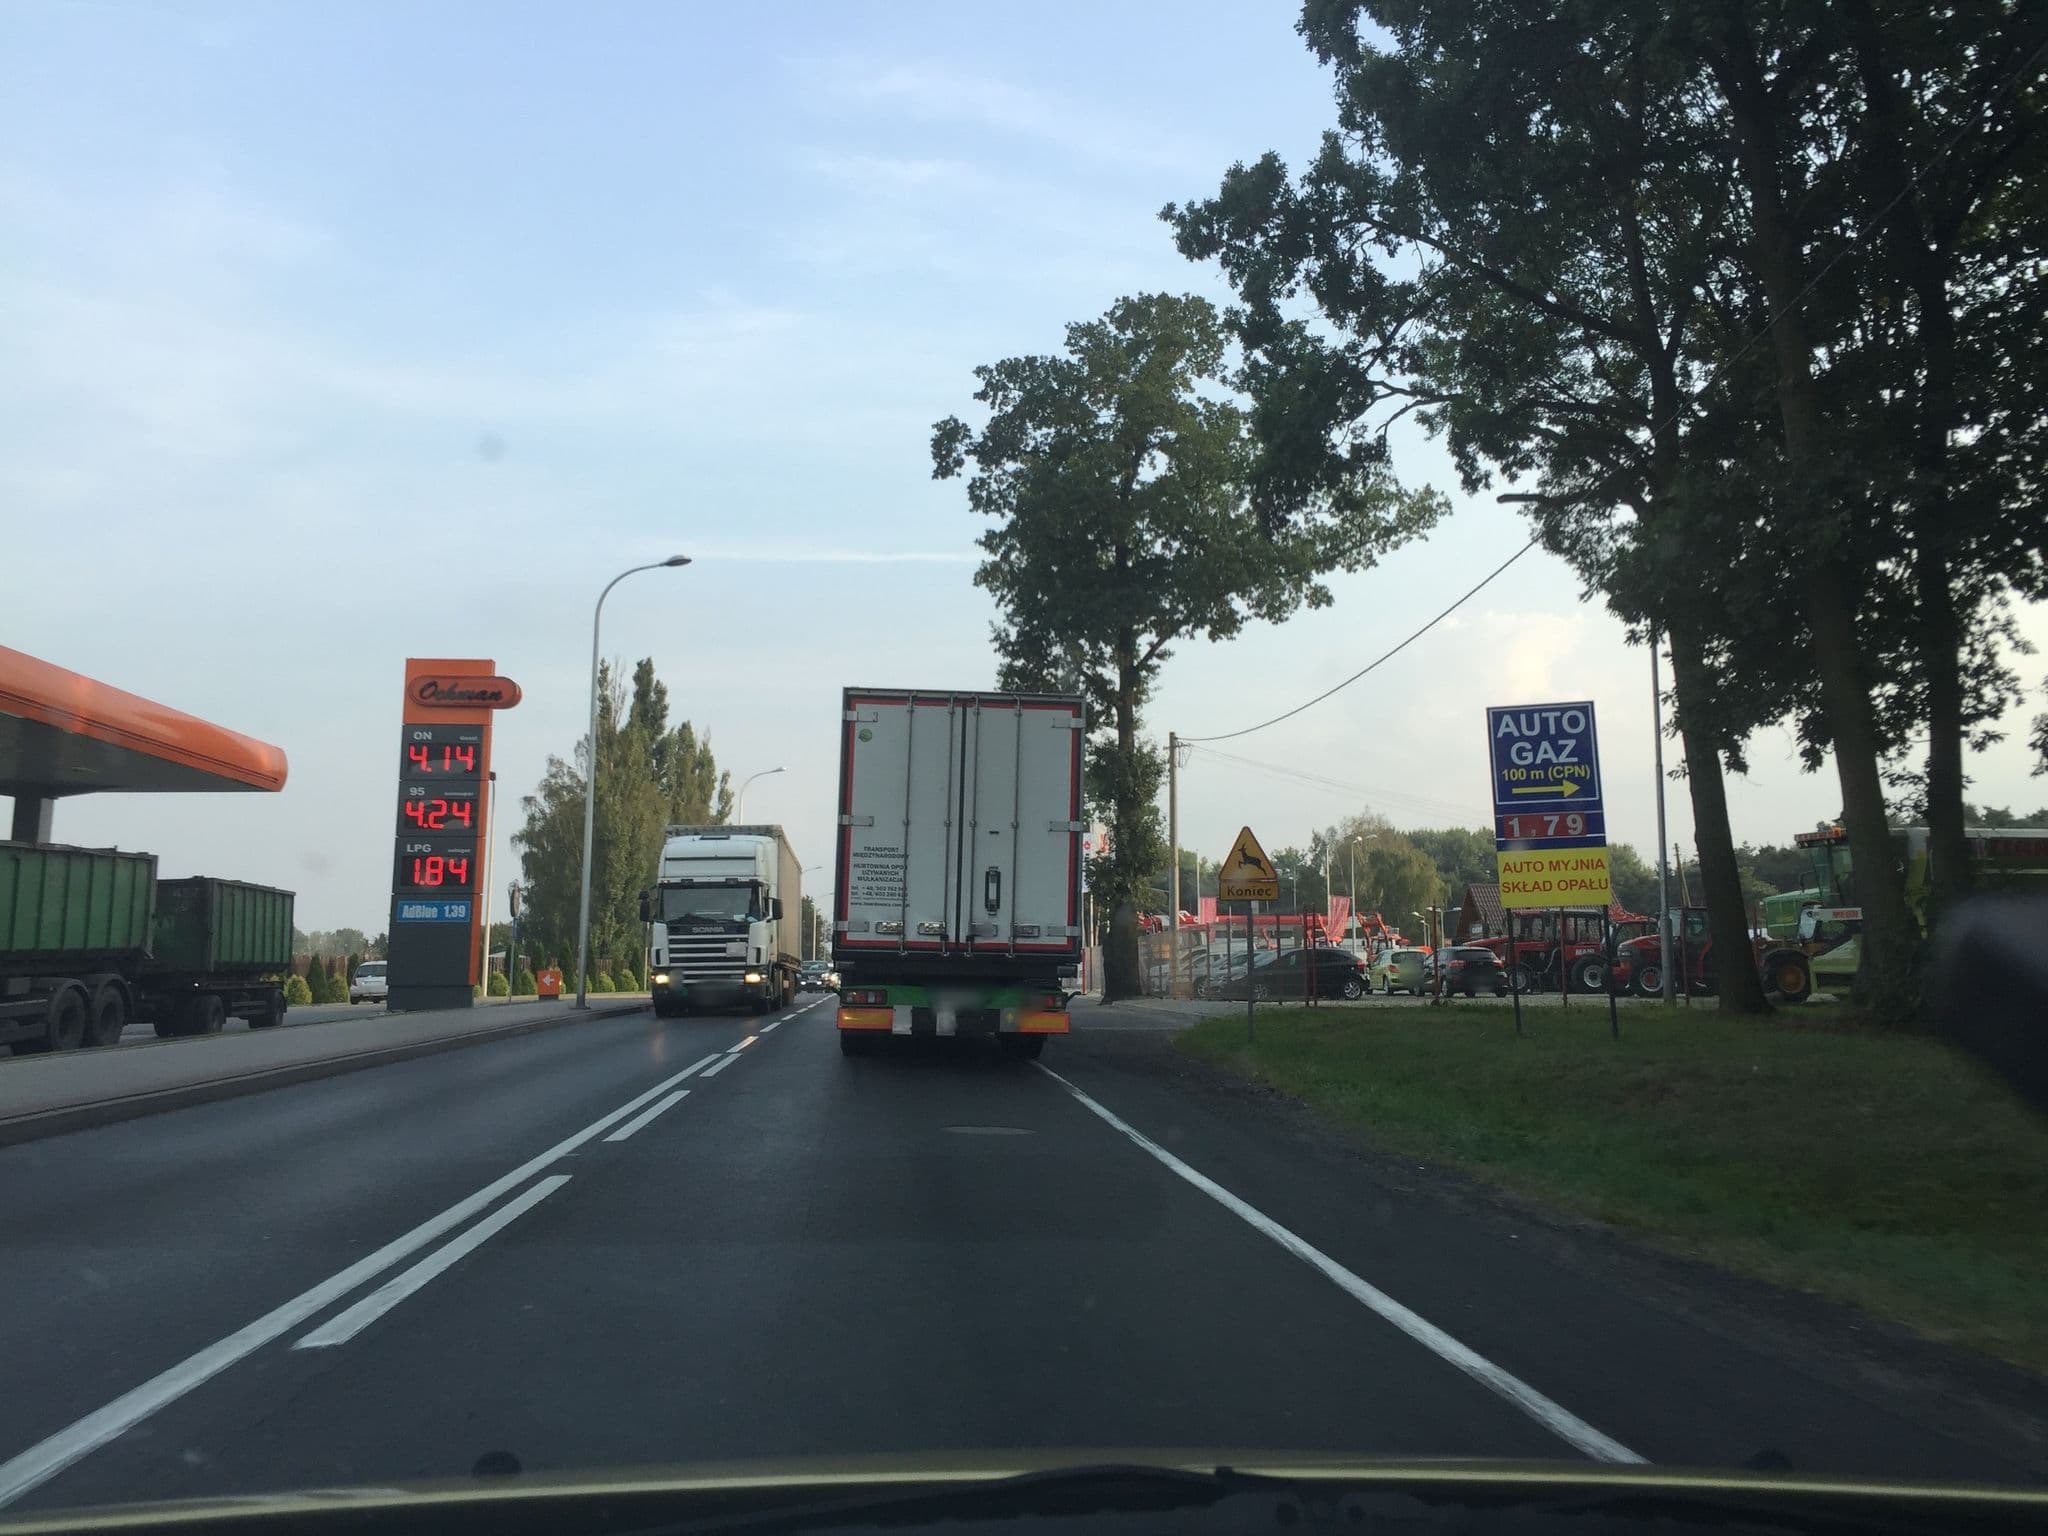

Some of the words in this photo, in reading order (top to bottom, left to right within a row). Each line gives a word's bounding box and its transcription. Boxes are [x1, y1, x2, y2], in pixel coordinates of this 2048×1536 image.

[1496, 710, 1586, 738] AUTO
[413, 731, 432, 741] ON
[409, 745, 474, 772] 4.14
[1510, 739, 1578, 765] GAZ
[1502, 768, 1527, 781] 100
[1530, 769, 1544, 780] m
[1548, 764, 1591, 782] (CPN)
[409, 787, 426, 796] 95
[405, 800, 471, 829] 4.24
[406, 844, 432, 853] LPG
[413, 857, 468, 886] 1.84
[1502, 861, 1544, 873] AUTO
[1549, 858, 1606, 872] MYJNIA
[1227, 886, 1272, 897] Koniec
[1502, 880, 1553, 893] SKŁAD
[1557, 878, 1609, 891] OPAŁU
[402, 904, 438, 919] AdBlue
[692, 926, 725, 934] SCANIA
